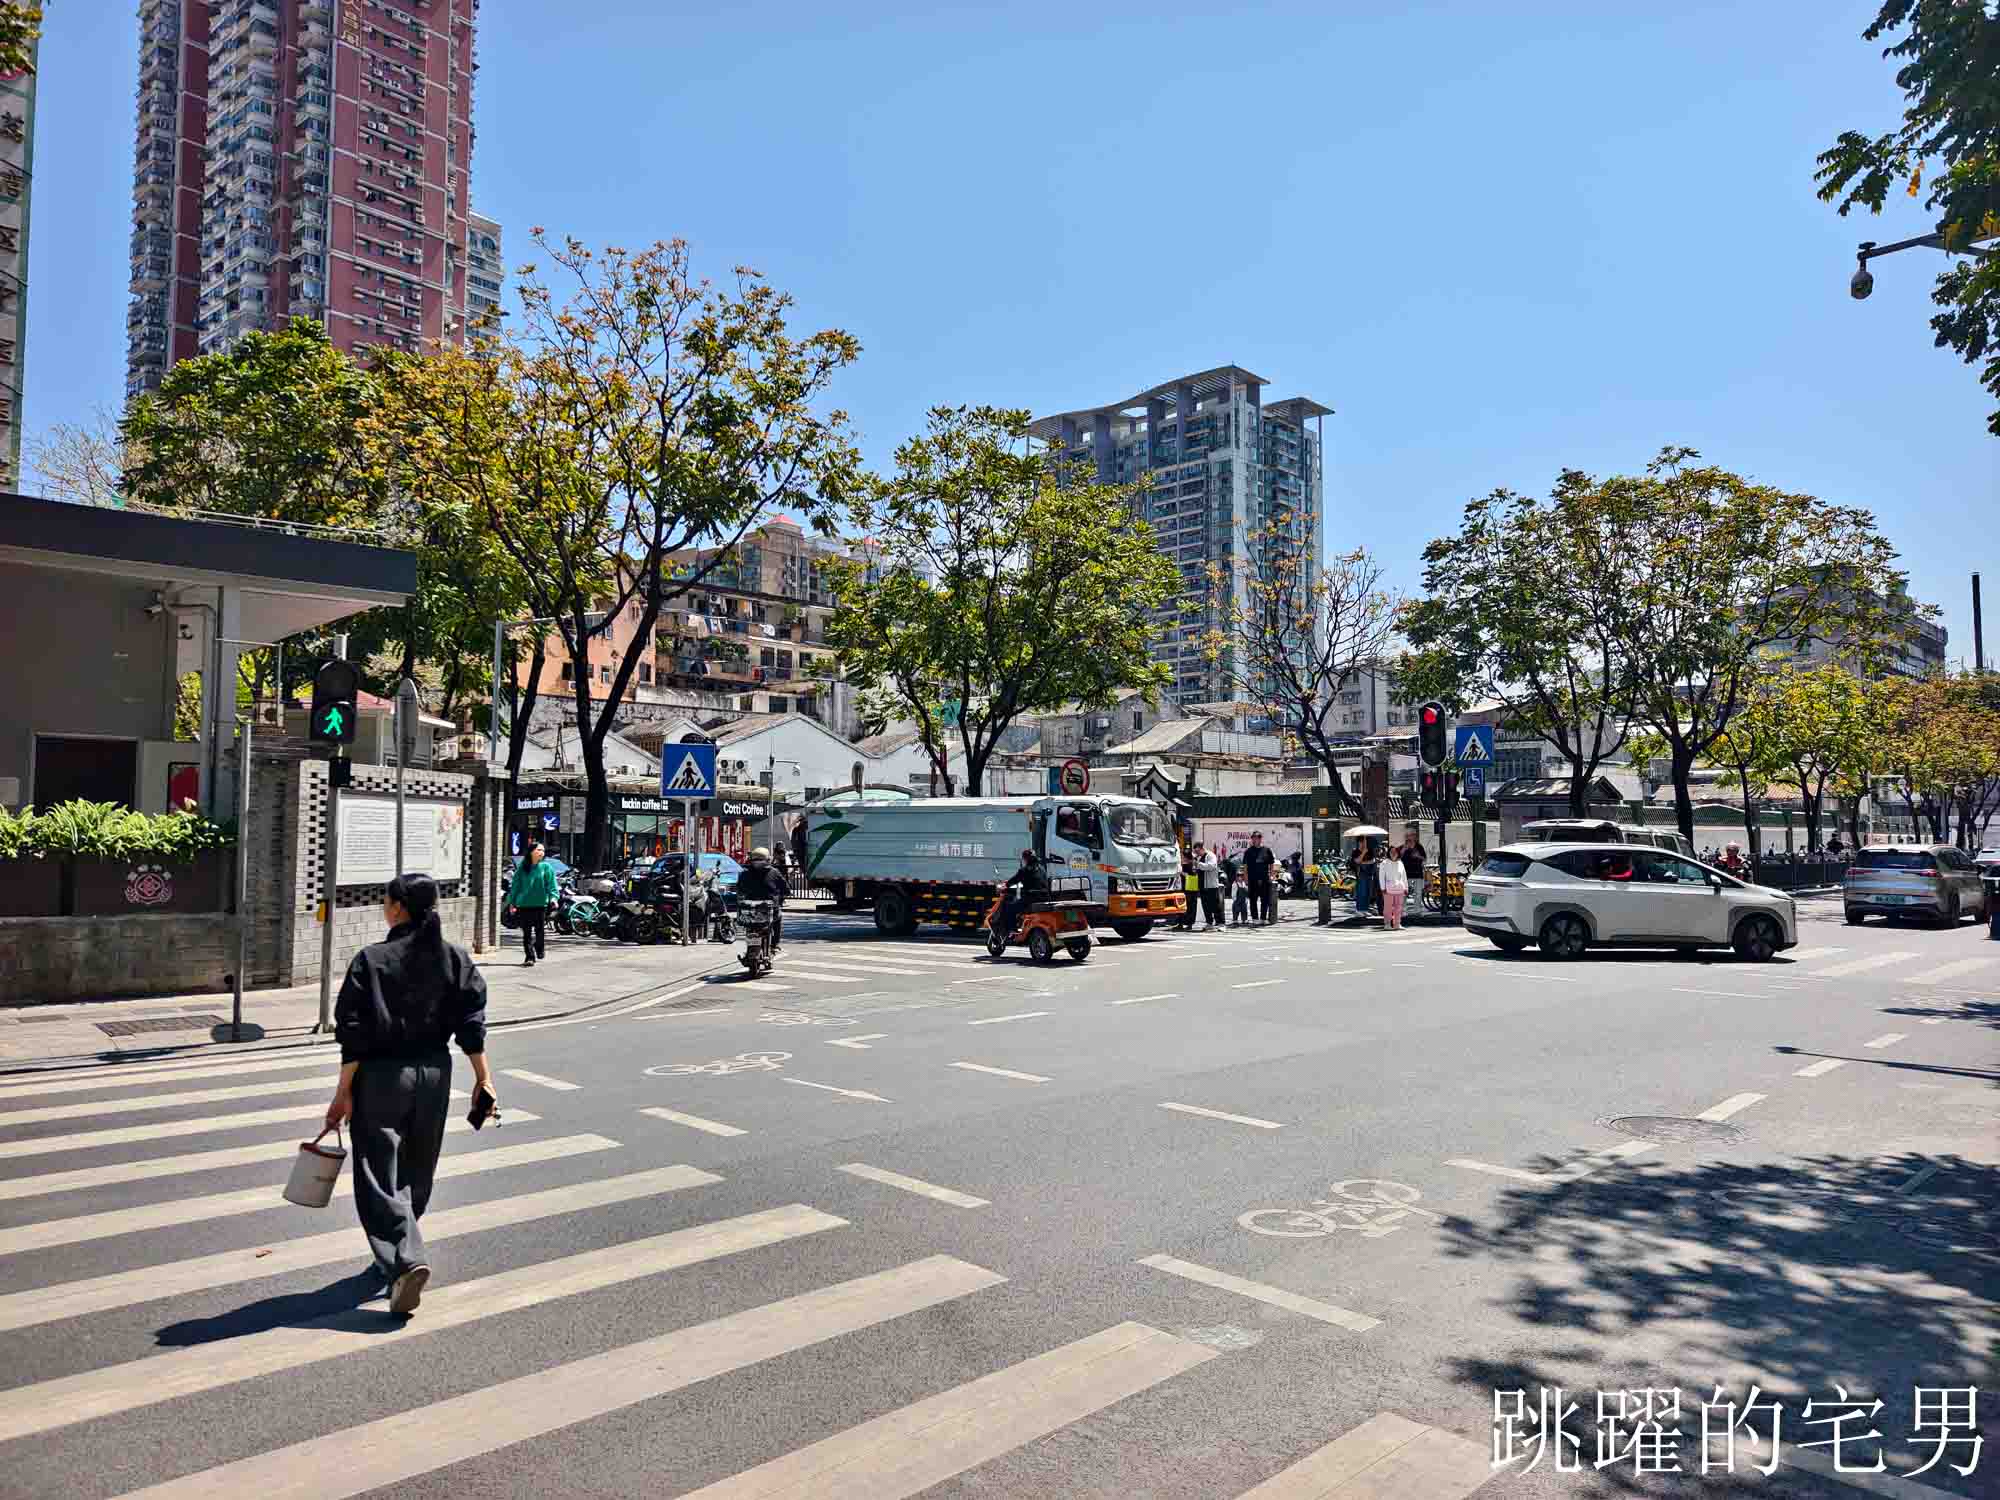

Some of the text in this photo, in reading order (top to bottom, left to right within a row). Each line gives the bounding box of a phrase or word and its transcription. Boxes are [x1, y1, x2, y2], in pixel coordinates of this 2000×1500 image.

[621, 796, 641, 809] luckin
[641, 798, 661, 810] coffee
[723, 801, 741, 815] Cotti
[741, 802, 764, 816] Coffee
